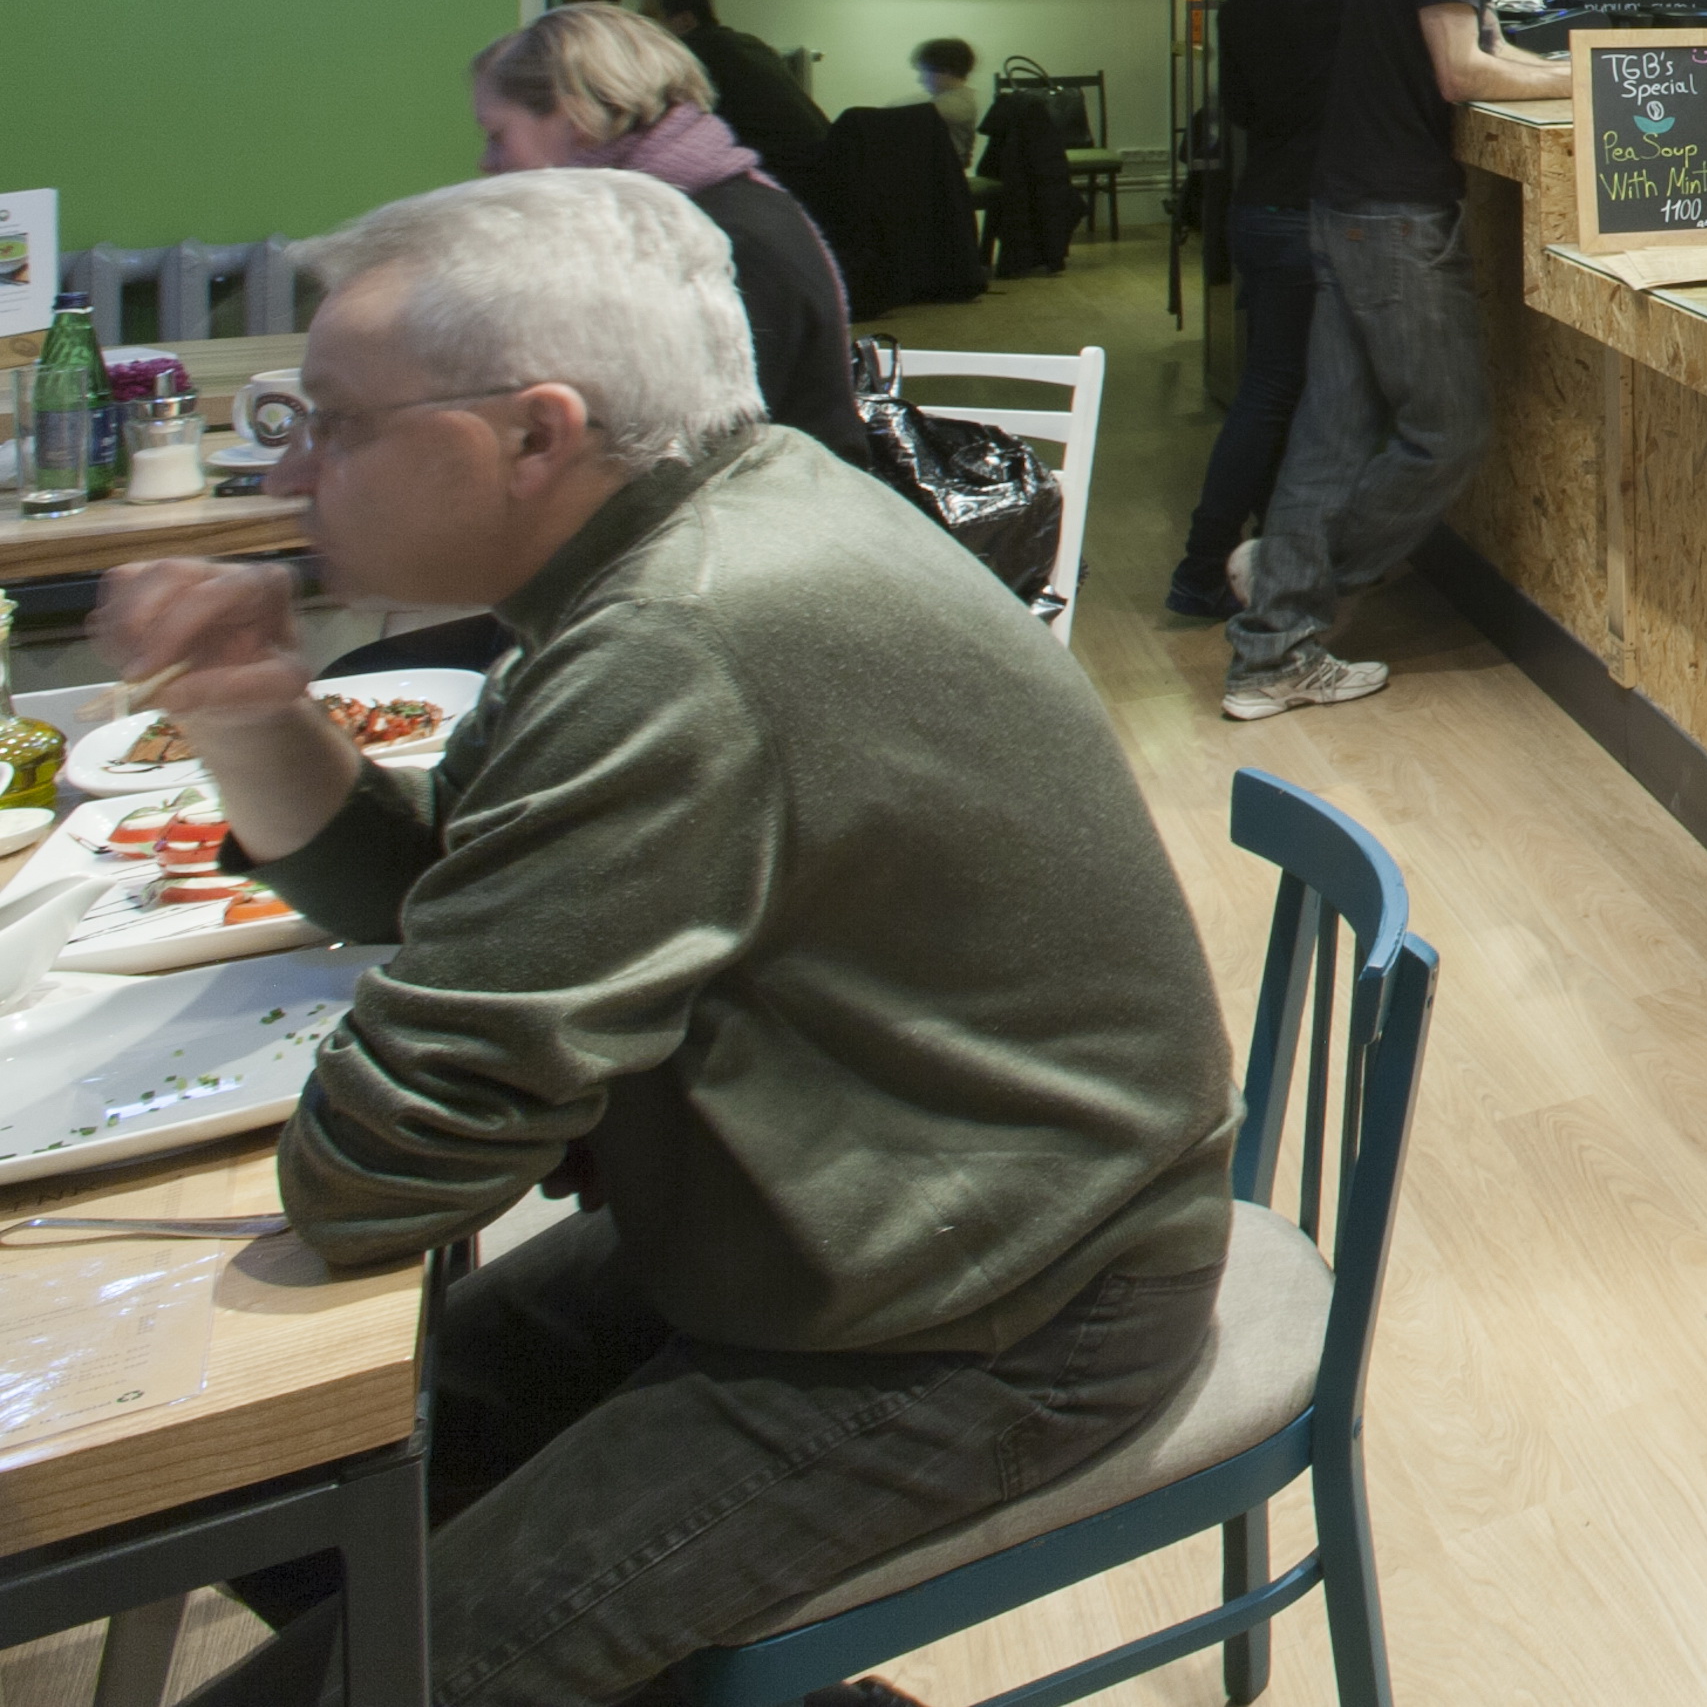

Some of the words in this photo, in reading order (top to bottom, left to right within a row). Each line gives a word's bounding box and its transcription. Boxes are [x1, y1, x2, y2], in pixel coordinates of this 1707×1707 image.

[1601, 51, 1674, 82] TGB's
[1621, 74, 1698, 106] Special
[1602, 131, 1636, 165] Pea
[1642, 132, 1698, 168] Soup
[1600, 169, 1659, 201] With
[1661, 198, 1702, 223] 1100
